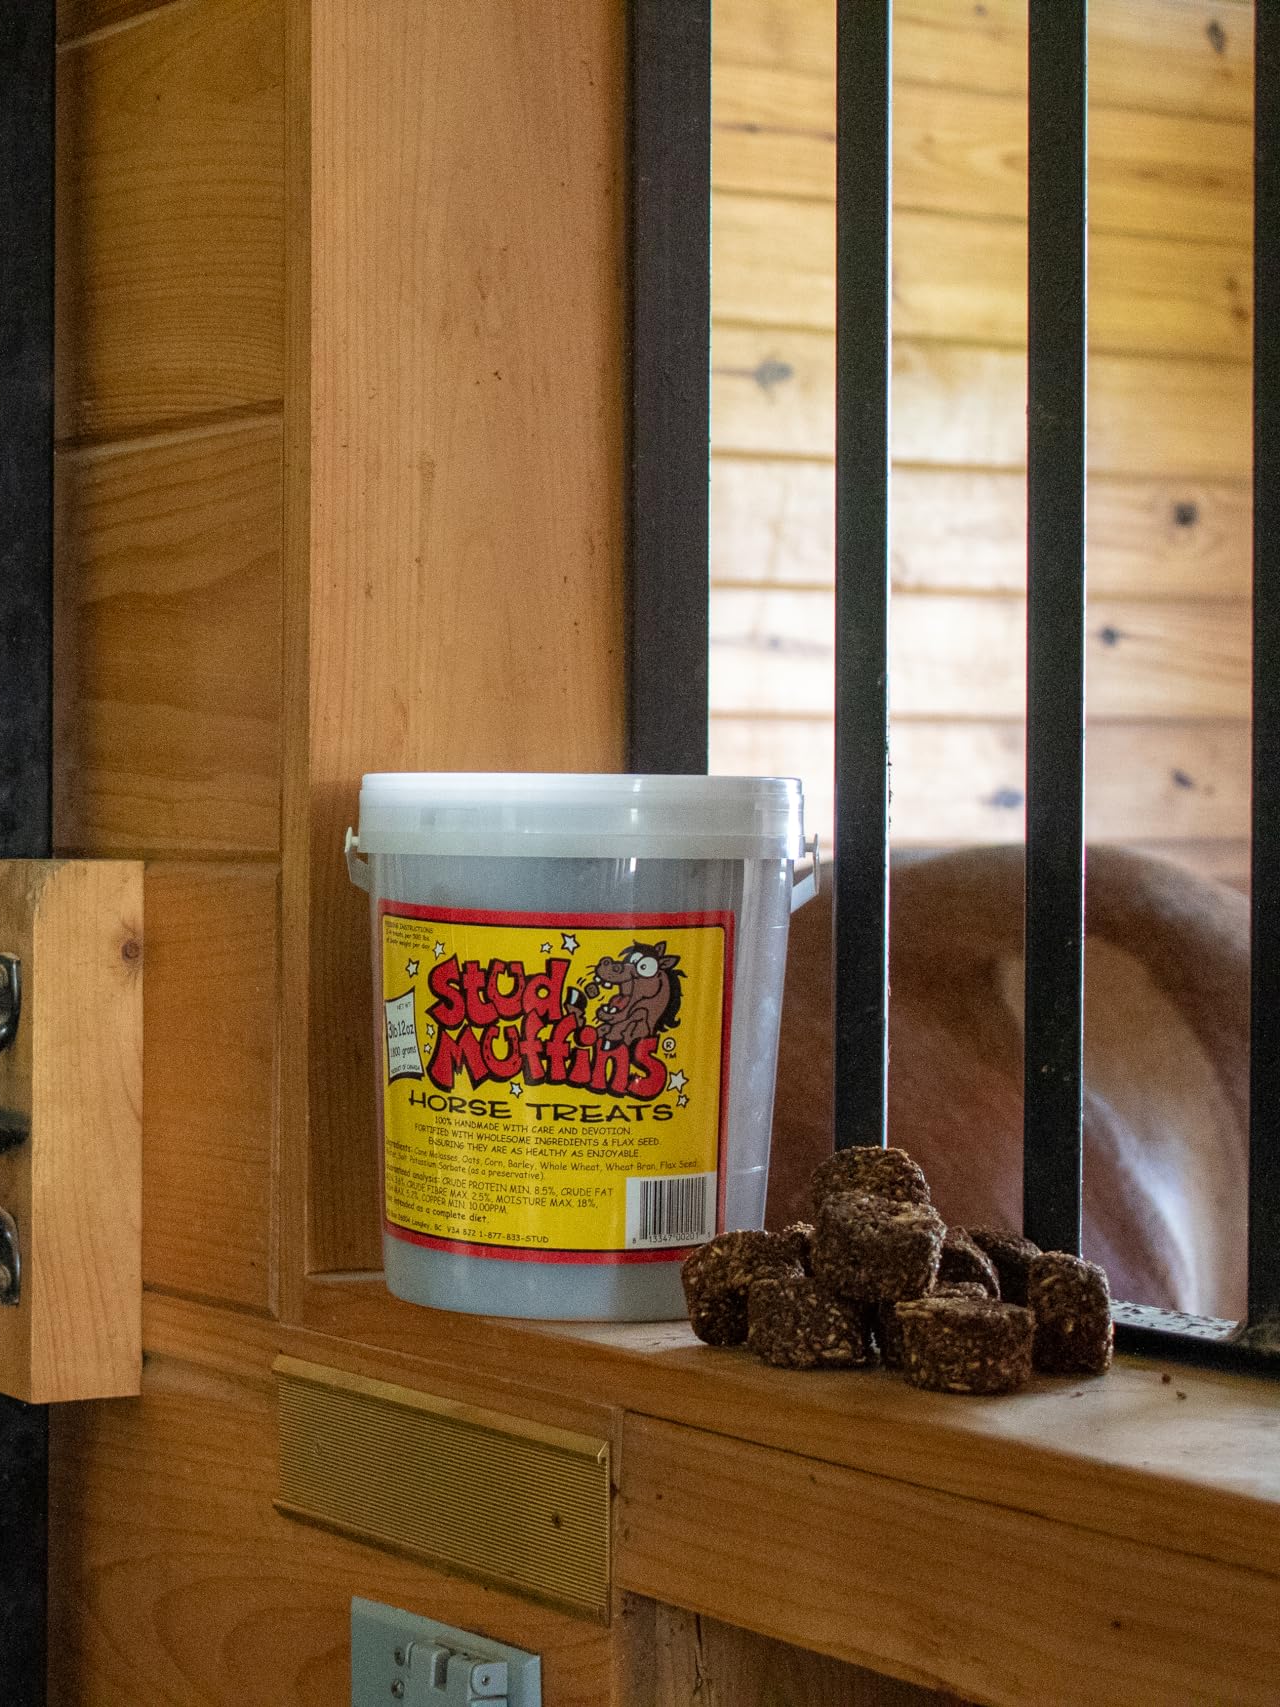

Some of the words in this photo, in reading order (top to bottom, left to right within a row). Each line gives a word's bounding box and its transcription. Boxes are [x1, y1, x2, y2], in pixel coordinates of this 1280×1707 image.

[424, 953, 571, 1028] Stud
[427, 1008, 668, 1102] Muffins
[408, 1090, 512, 1118] HORSE
[525, 1103, 674, 1123] TREATS
[414, 1123, 449, 1137] FORTIFIED
[452, 1129, 474, 1140] WITH
[476, 1132, 531, 1144] WHOLESOME
[534, 1137, 598, 1146] INGREDIENTS
[602, 1138, 608, 1146] &
[612, 1138, 634, 1146] FLAX
[435, 1116, 452, 1126] 100%
[454, 1119, 500, 1132] HANDMADE
[502, 1124, 528, 1133] WITH
[532, 1126, 554, 1134] CARE
[558, 1127, 578, 1135] AND
[467, 1142, 488, 1152] THEY
[492, 1145, 507, 1154] ARE
[510, 1147, 523, 1156] AS
[526, 1148, 568, 1158] HEALTHY
[571, 1150, 584, 1158] AS
[468, 1165, 480, 1176] (as
[540, 1162, 568, 1171] Whole
[606, 1163, 634, 1172] Wheat
[660, 1161, 677, 1170] Flax
[442, 1176, 466, 1188] CRUDE
[468, 1180, 507, 1192] PROTEIN
[560, 1187, 592, 1197] CRUDE
[594, 1187, 613, 1197] FAT
[496, 1195, 546, 1207] MOISTURE
[432, 1210, 466, 1220] complete
